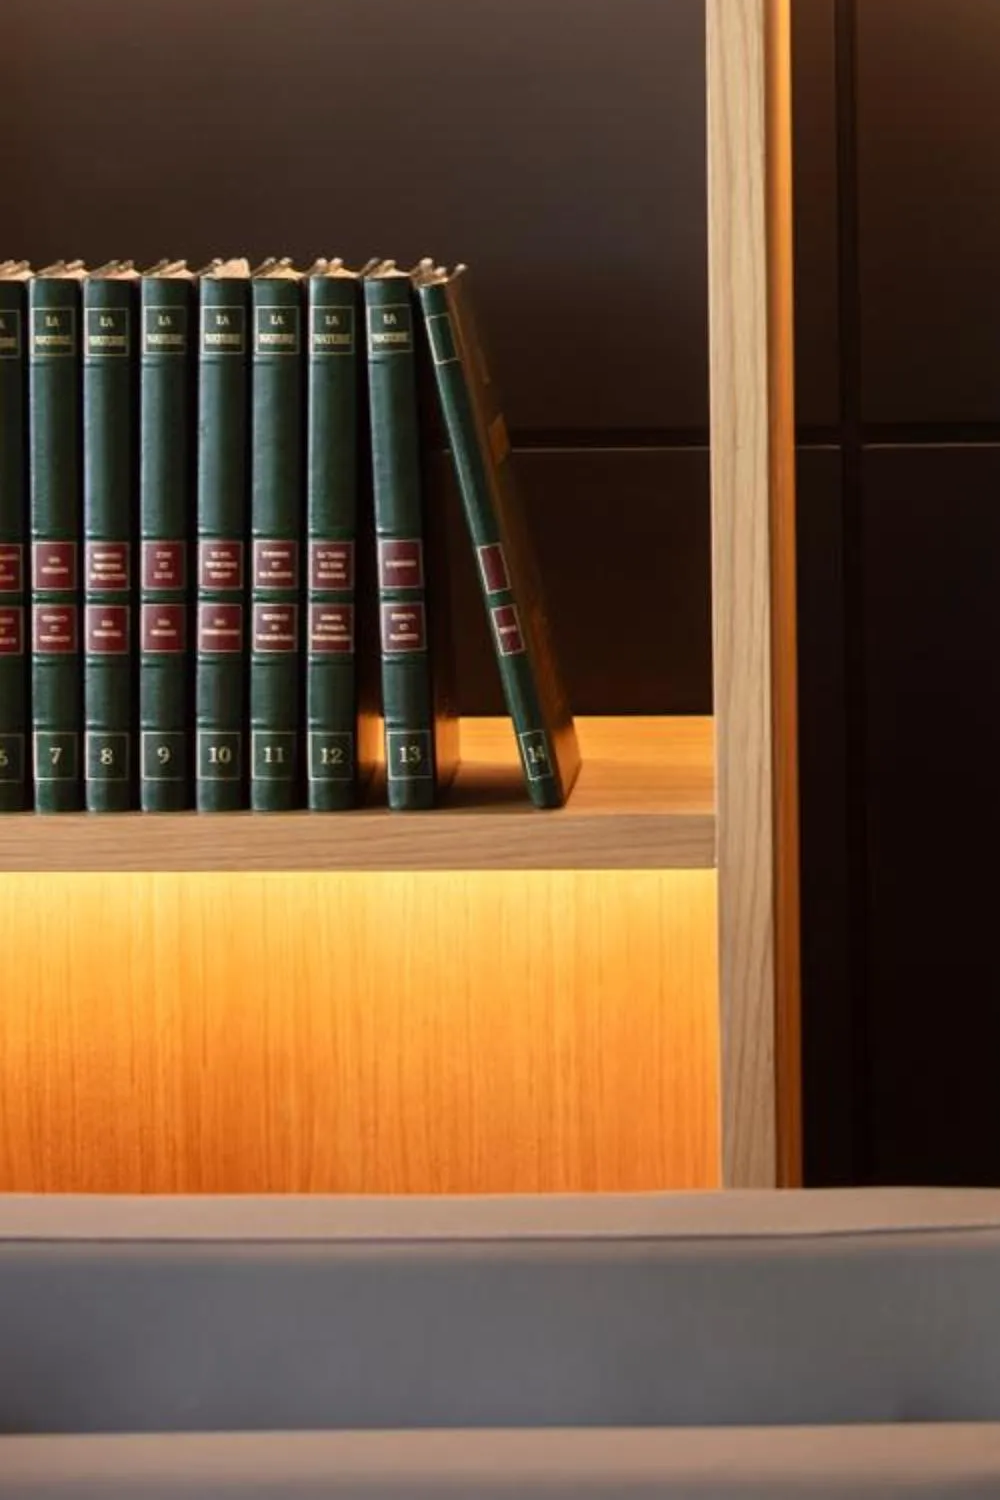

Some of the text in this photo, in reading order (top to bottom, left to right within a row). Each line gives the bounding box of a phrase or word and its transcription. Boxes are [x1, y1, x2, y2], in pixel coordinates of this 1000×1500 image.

[49, 747, 62, 765] 7
[100, 747, 113, 765] 8
[156, 746, 170, 764] 9
[208, 747, 231, 763] 10
[263, 746, 284, 763] 11
[319, 747, 344, 764] 12
[399, 745, 421, 763] 13
